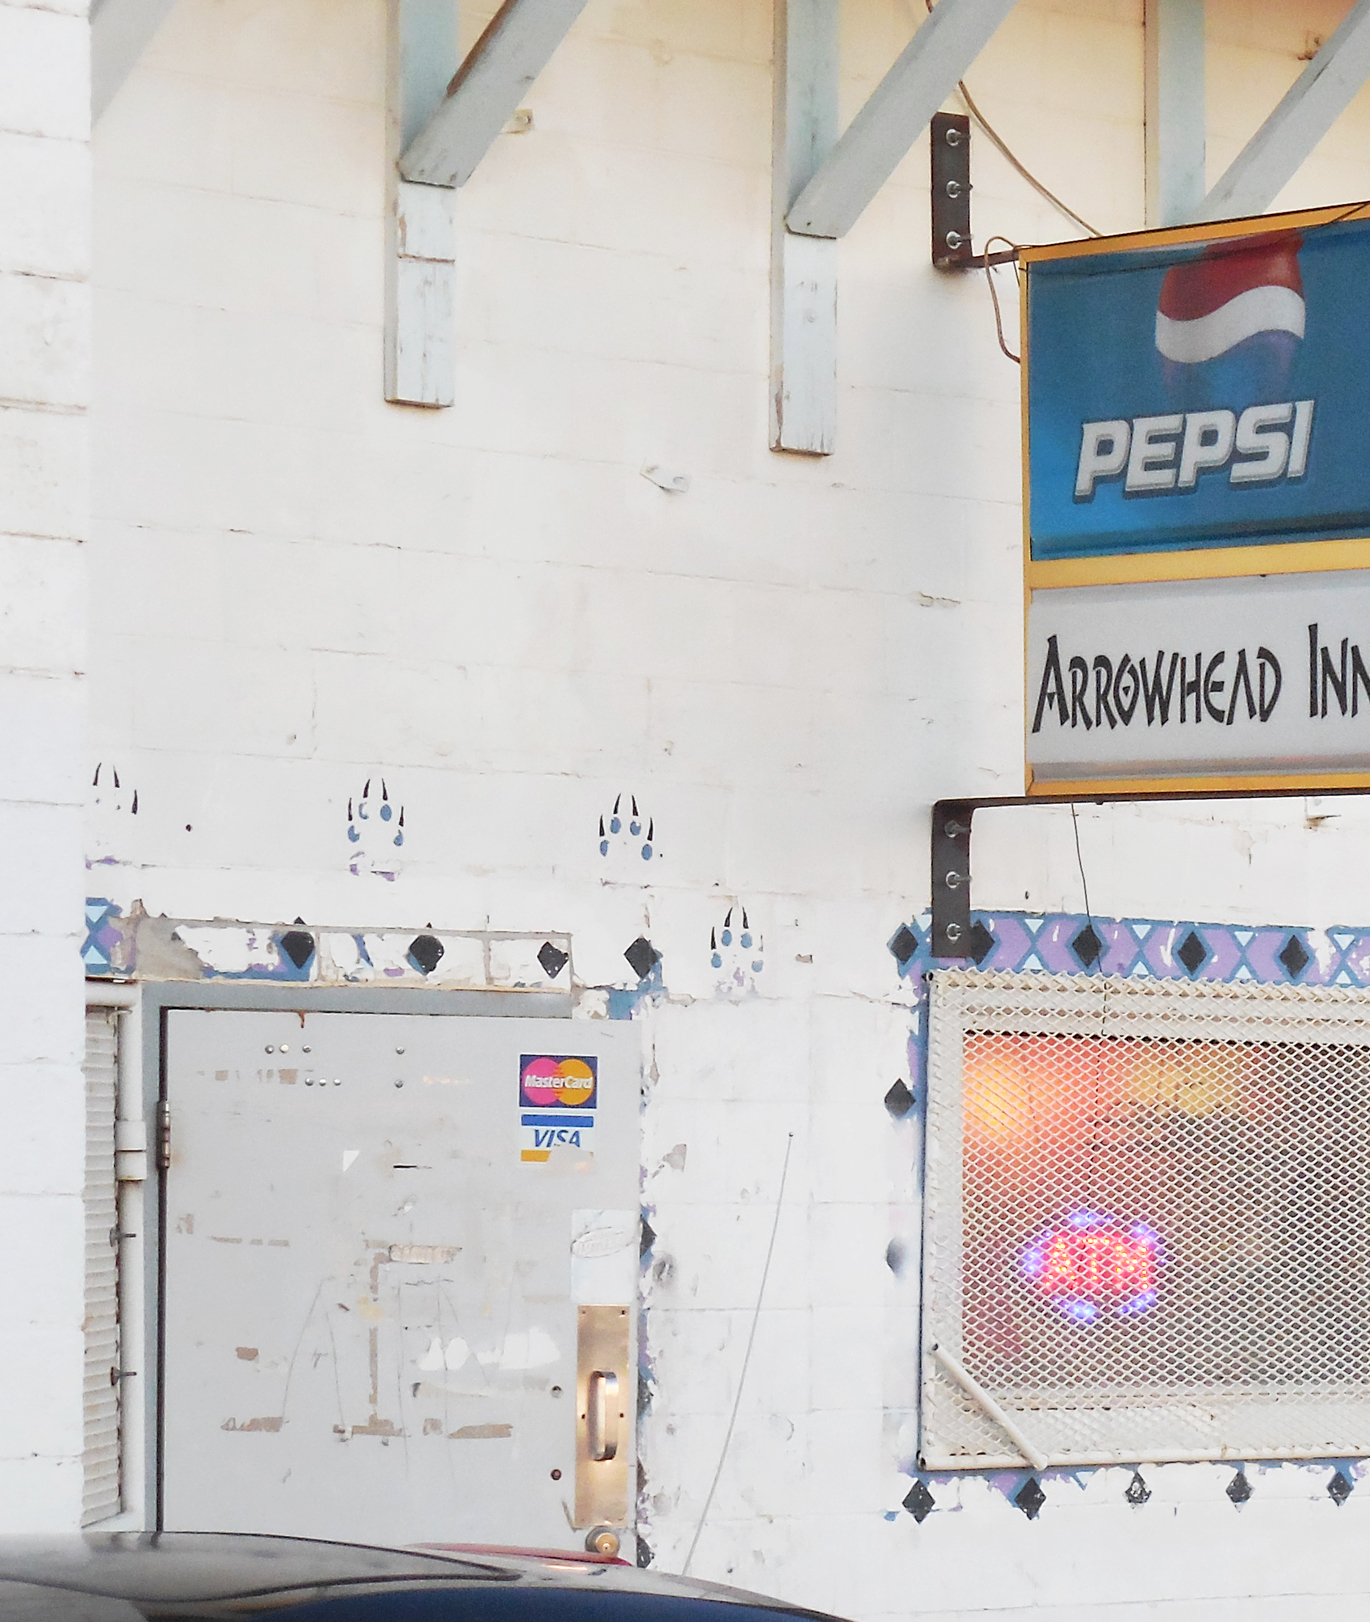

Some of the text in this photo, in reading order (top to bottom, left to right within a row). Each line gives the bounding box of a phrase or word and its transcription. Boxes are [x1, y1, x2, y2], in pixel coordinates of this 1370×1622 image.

[1073, 399, 1316, 502] PEPSI
[523, 1074, 594, 1089] MasterCard
[534, 1128, 581, 1148] VISA
[1044, 1236, 1151, 1293] ATM
